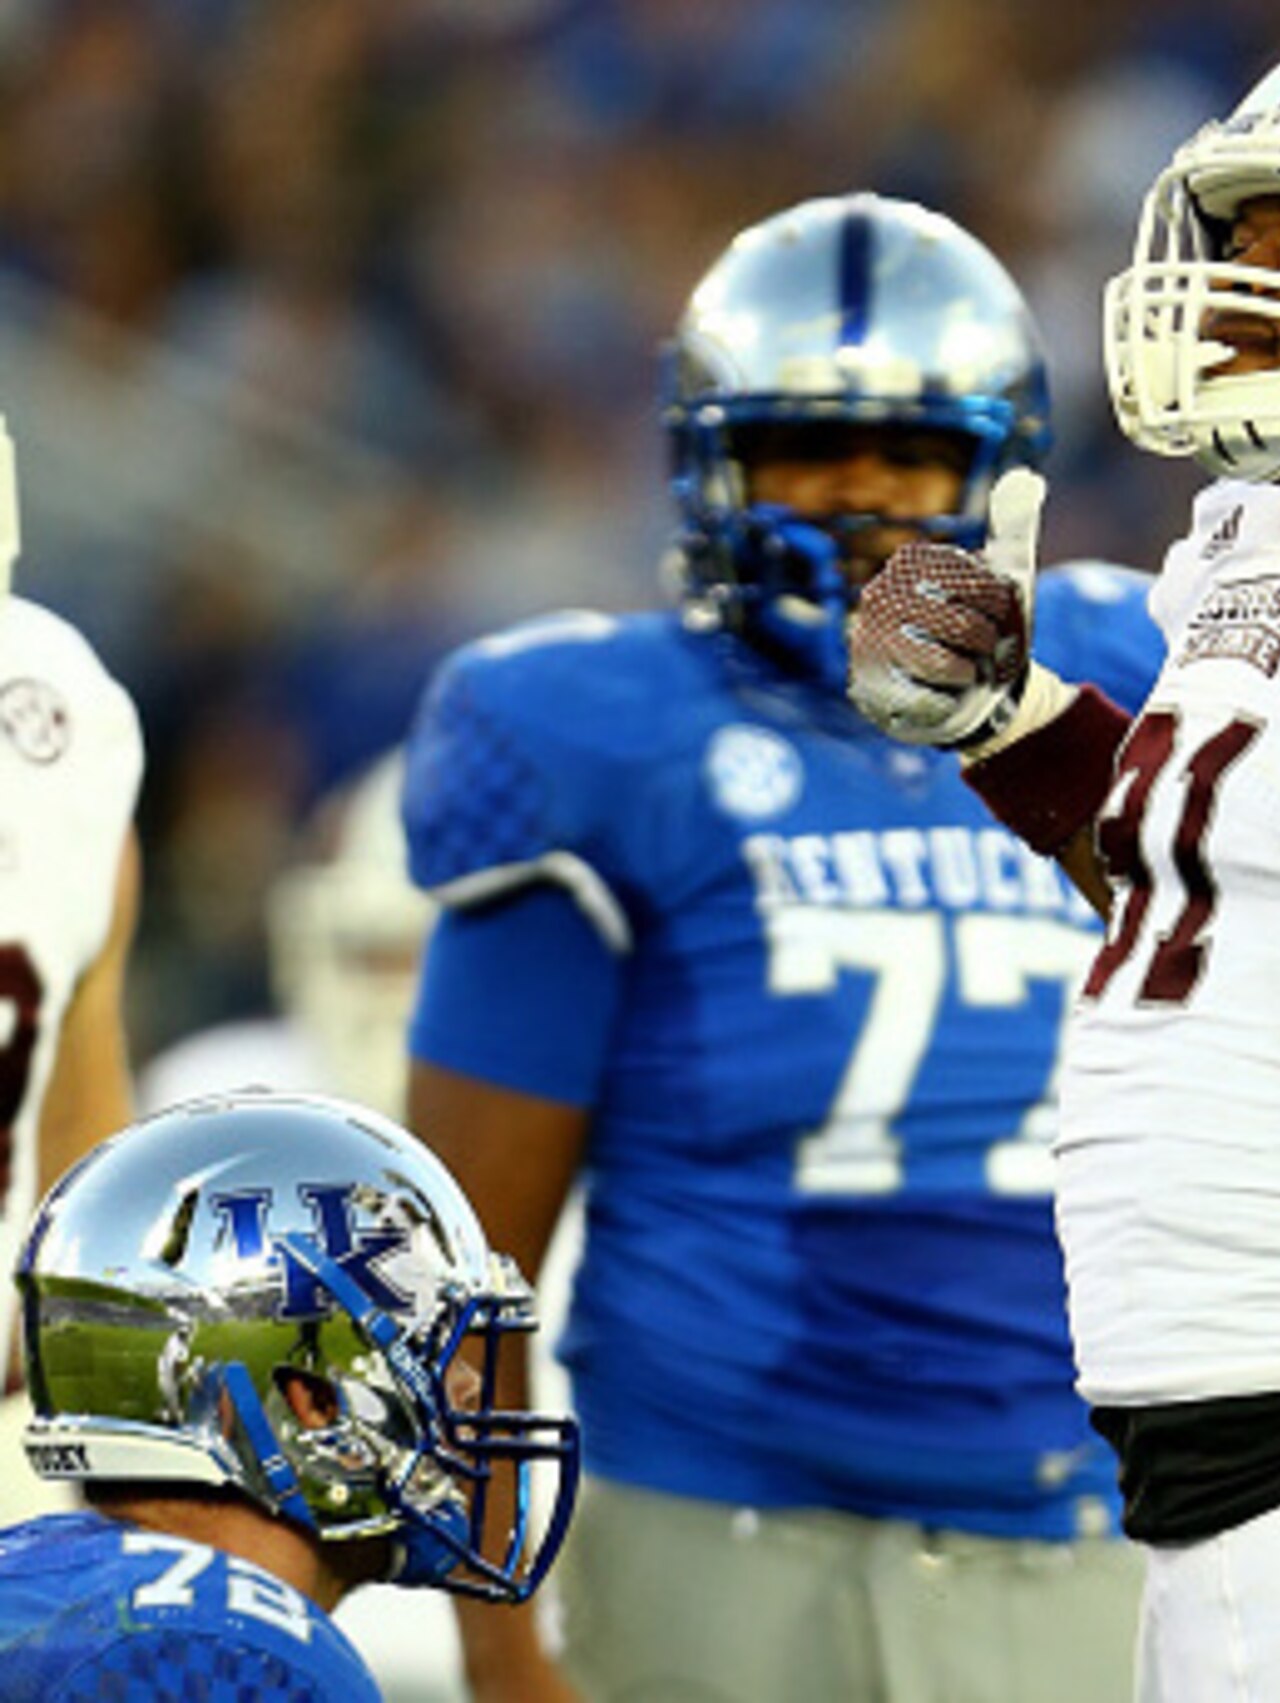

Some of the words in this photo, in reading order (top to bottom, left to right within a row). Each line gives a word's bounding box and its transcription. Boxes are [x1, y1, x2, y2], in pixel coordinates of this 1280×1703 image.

[743, 824, 1102, 922] KENTUCK
[1083, 709, 1266, 1007] 91
[766, 904, 1106, 1194] 77
[121, 1528, 313, 1646] 72
